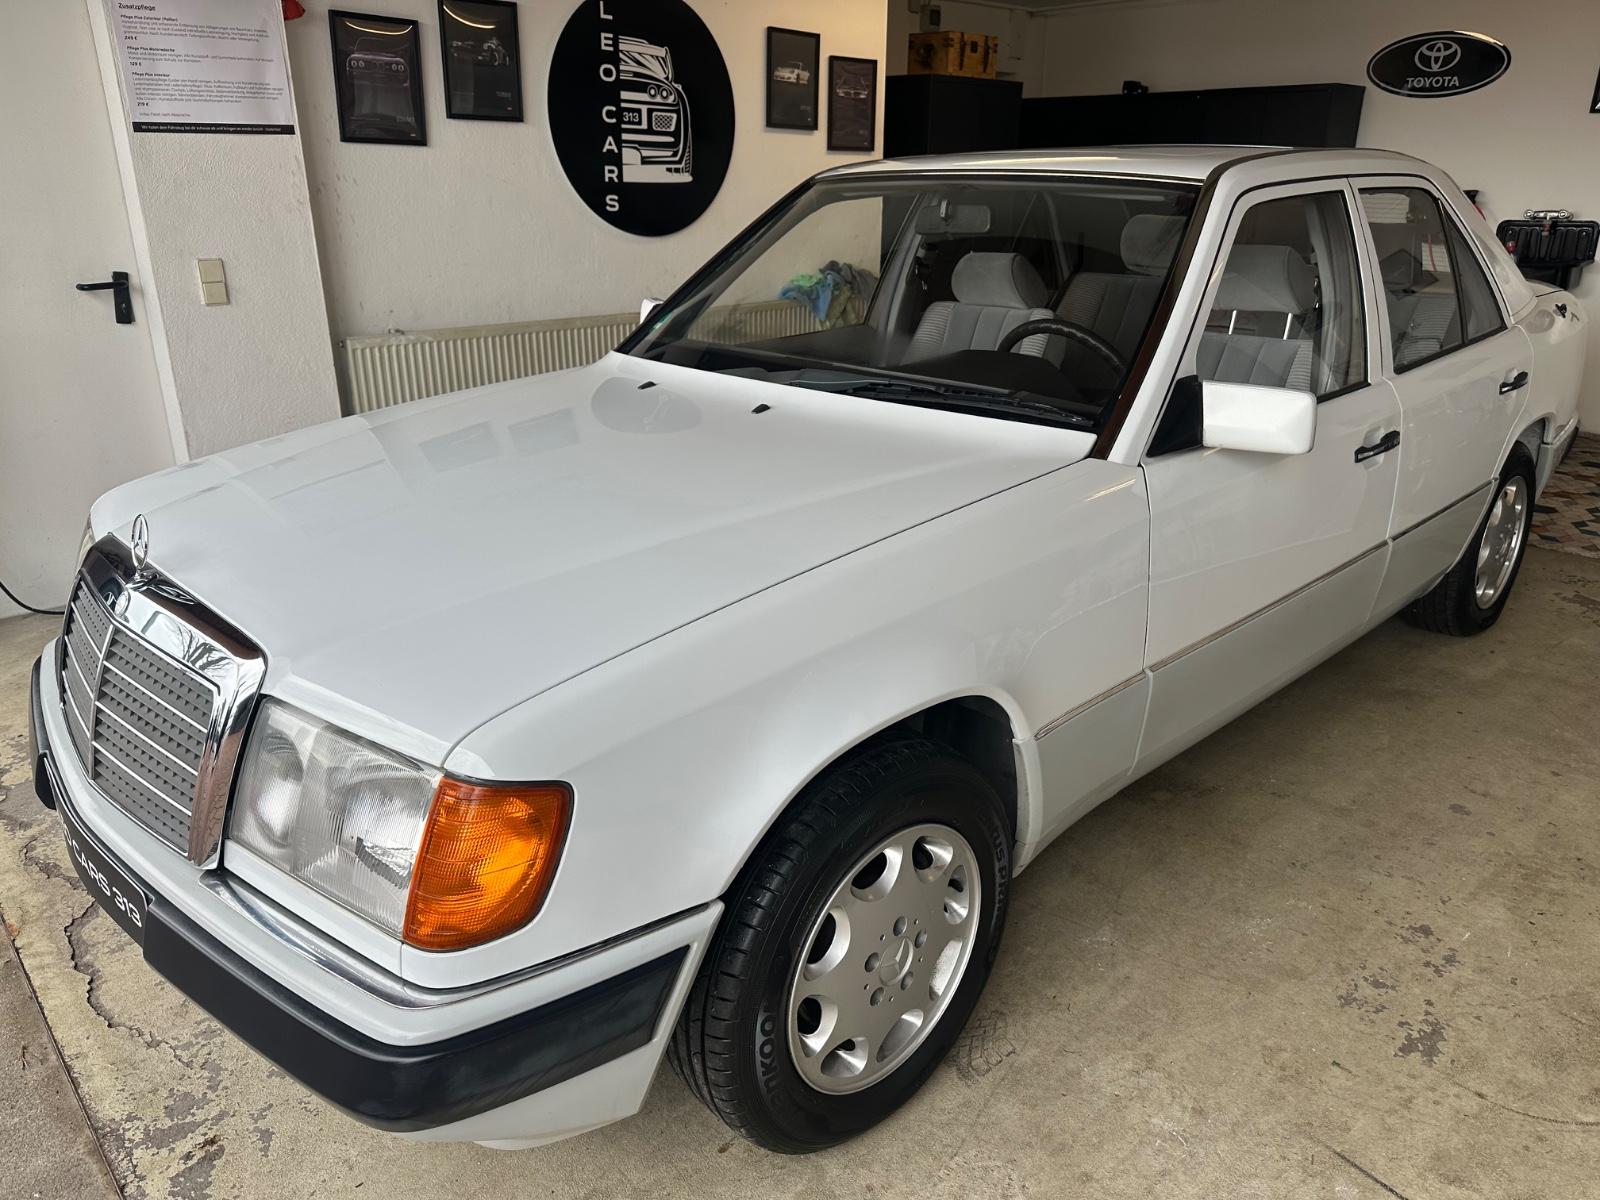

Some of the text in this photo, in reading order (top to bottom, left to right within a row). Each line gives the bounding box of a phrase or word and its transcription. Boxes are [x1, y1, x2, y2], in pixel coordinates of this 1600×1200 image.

[118, 2, 156, 11] Zusatzpflege
[1406, 76, 1460, 88] TOYOTA
[600, 0, 620, 212] LEO CARS
[622, 111, 640, 122] 313
[72, 839, 142, 928] CARS 313
